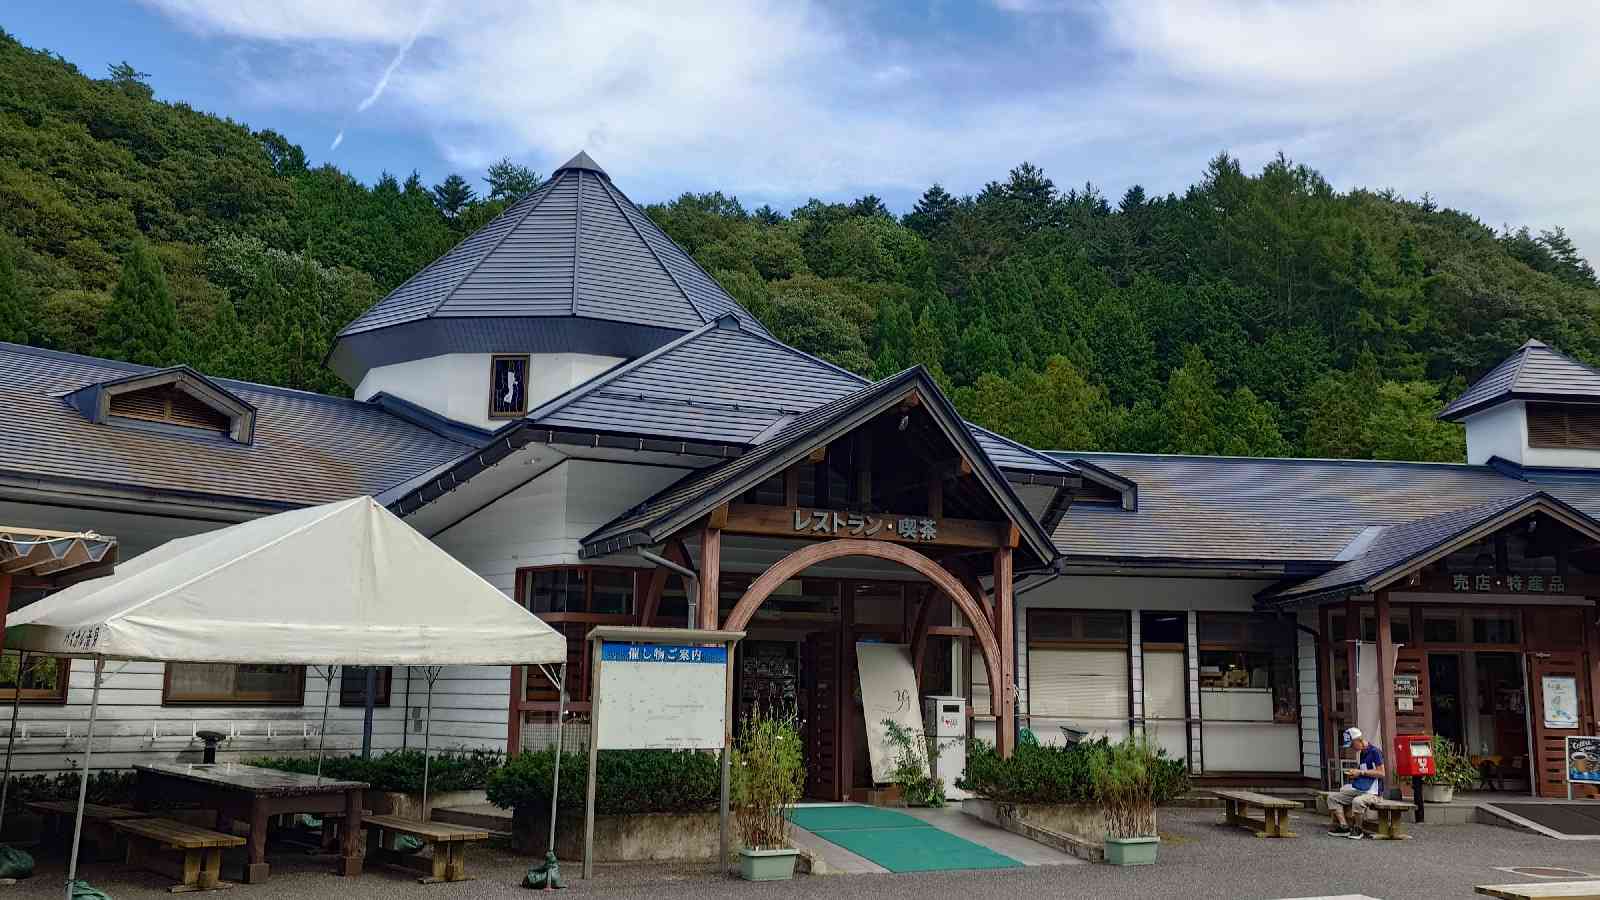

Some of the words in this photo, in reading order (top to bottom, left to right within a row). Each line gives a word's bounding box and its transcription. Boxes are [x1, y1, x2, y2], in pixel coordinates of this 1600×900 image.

[795, 509, 937, 541] レストラン・喫茶
[1453, 574, 1565, 593] 売店・特産品
[628, 647, 702, 661] 催し物ご案内
